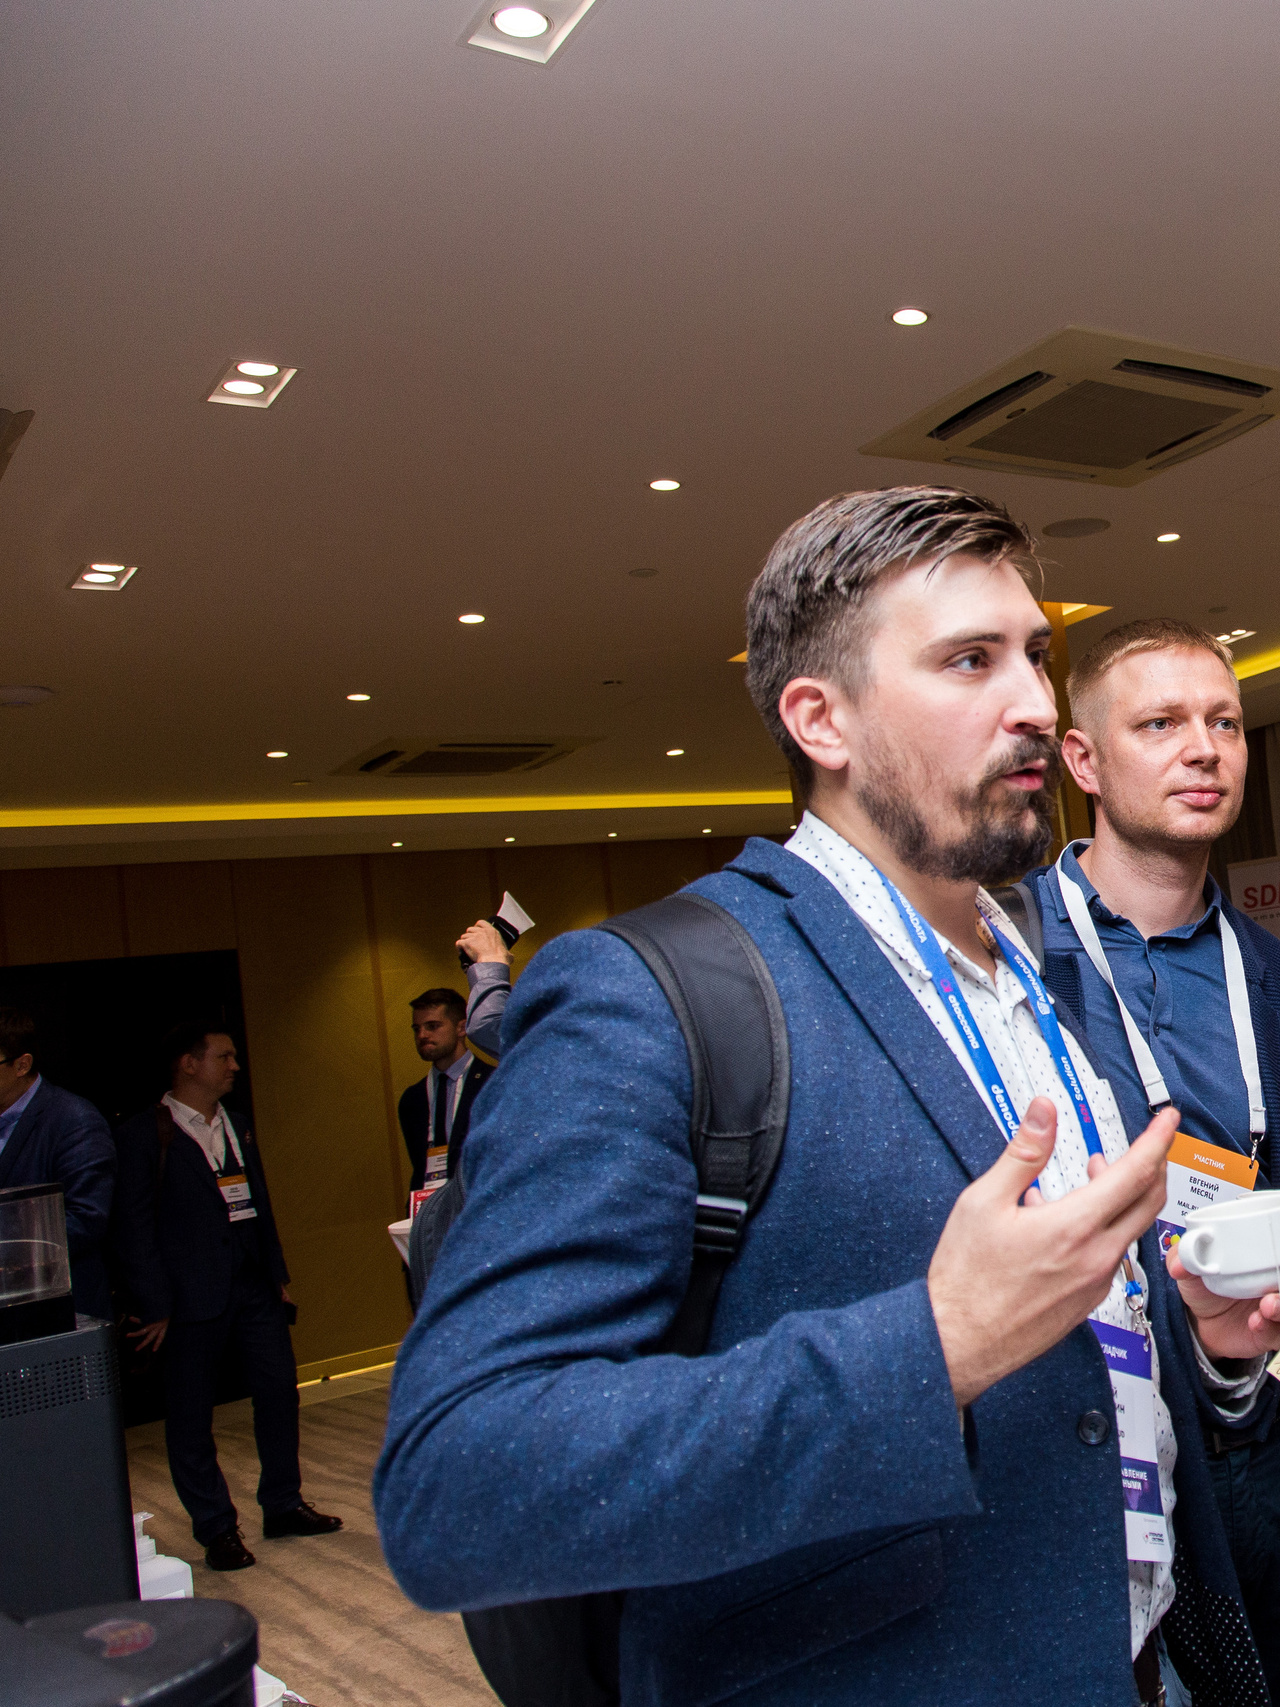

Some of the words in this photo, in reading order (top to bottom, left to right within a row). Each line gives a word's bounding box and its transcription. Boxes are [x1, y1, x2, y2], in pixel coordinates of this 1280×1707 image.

[1014, 954, 1047, 1003] ARENADATA
[948, 994, 980, 1050] ataccama
[1061, 1056, 1084, 1102] Solution
[1079, 1103, 1092, 1124] SDI
[1193, 1153, 1226, 1171] УЧАСТНИК
[1189, 1176, 1220, 1192] ЕВГЕНИЙ
[1190, 1186, 1214, 1202] МЕСЯЦ
